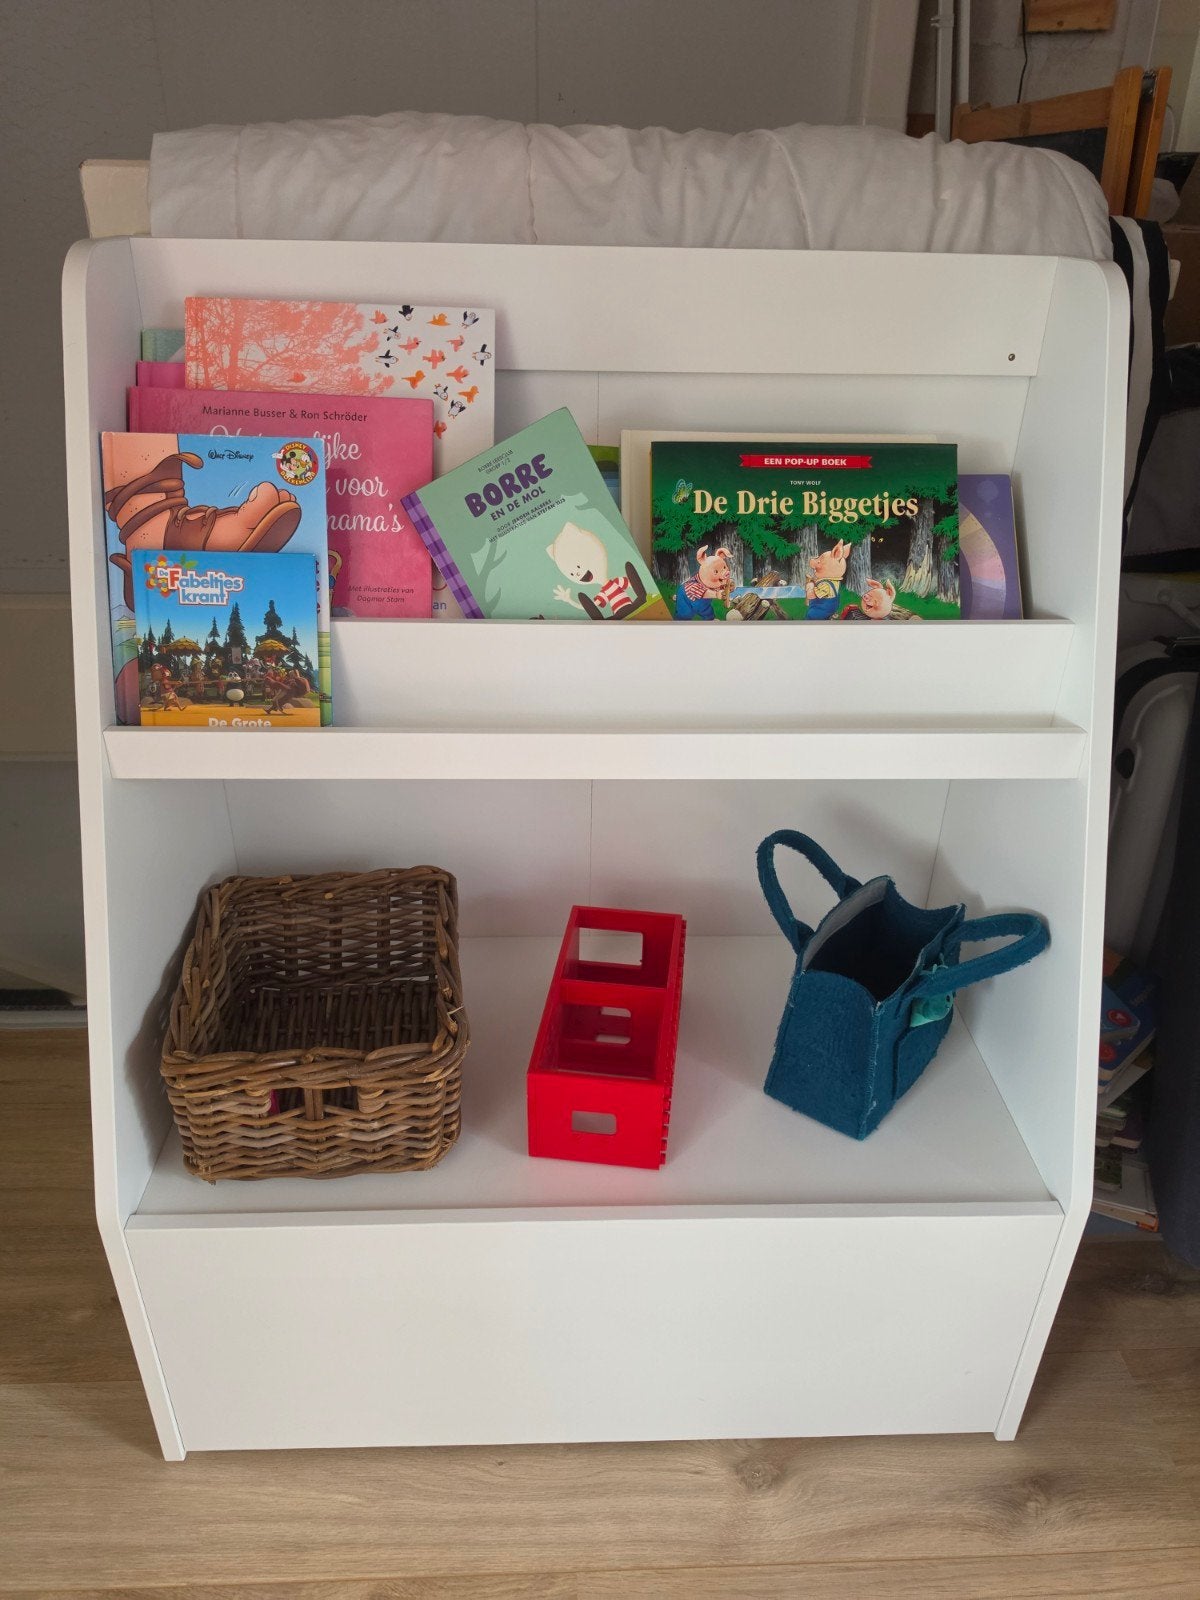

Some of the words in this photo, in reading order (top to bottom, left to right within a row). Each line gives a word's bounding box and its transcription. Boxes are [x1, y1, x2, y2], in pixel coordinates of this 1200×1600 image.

[202, 406, 250, 416] Marianne
[253, 408, 286, 418] Busser
[289, 410, 297, 419] &
[301, 410, 320, 420] Ron
[323, 411, 368, 422] Schröder
[208, 449, 225, 460] Walt
[224, 450, 254, 463] Disney
[785, 458, 819, 466] POP-UP
[822, 458, 847, 466] BOEK
[335, 476, 389, 497] voor
[464, 453, 554, 518] BORRE
[490, 508, 505, 521] EN
[506, 500, 520, 512] DE
[522, 486, 546, 504] MOL
[693, 490, 728, 514] De
[737, 490, 794, 515] Drie
[802, 491, 919, 523] Biggetjes
[159, 569, 169, 577] De
[169, 570, 241, 591] Fabeltjes
[181, 588, 227, 603] krant
[357, 595, 385, 603] Dagmar
[208, 717, 228, 728] De
[231, 717, 272, 728] Grote
